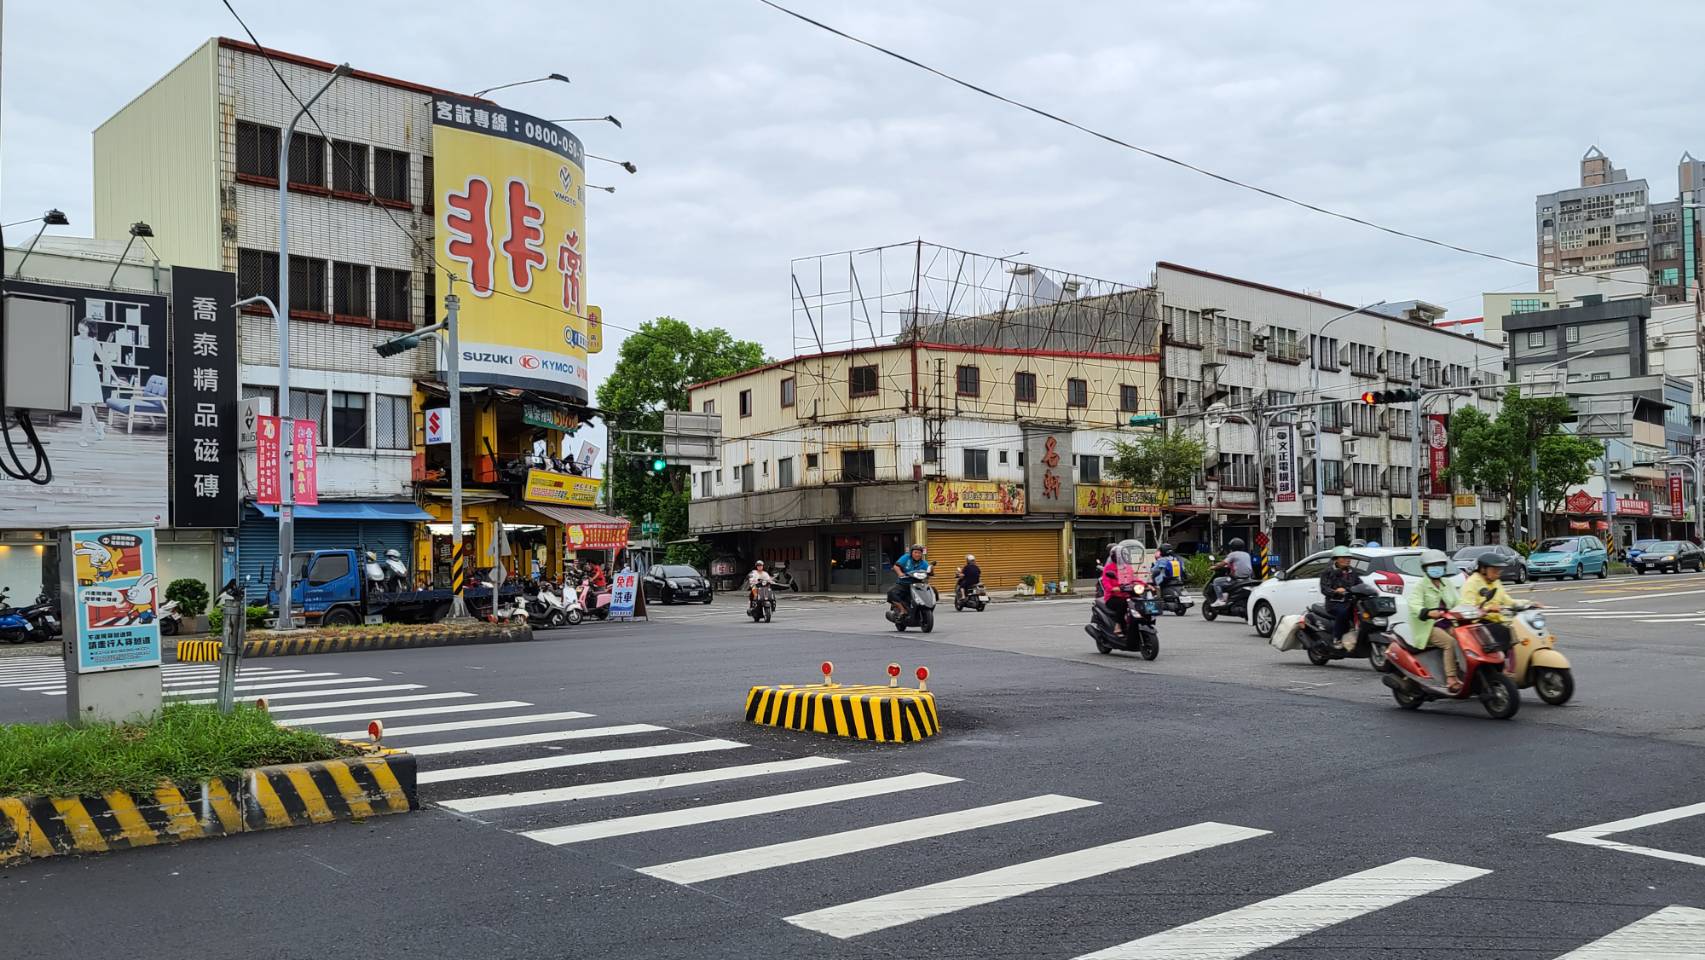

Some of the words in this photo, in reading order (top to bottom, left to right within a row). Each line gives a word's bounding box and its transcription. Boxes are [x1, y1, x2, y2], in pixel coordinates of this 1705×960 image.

[463, 351, 513, 365] SUZUKI
[541, 359, 574, 375] KYMCO
[192, 296, 219, 498] 喬泰精品磁磚
[616, 575, 635, 588] 免費
[613, 591, 633, 604] 洗車
